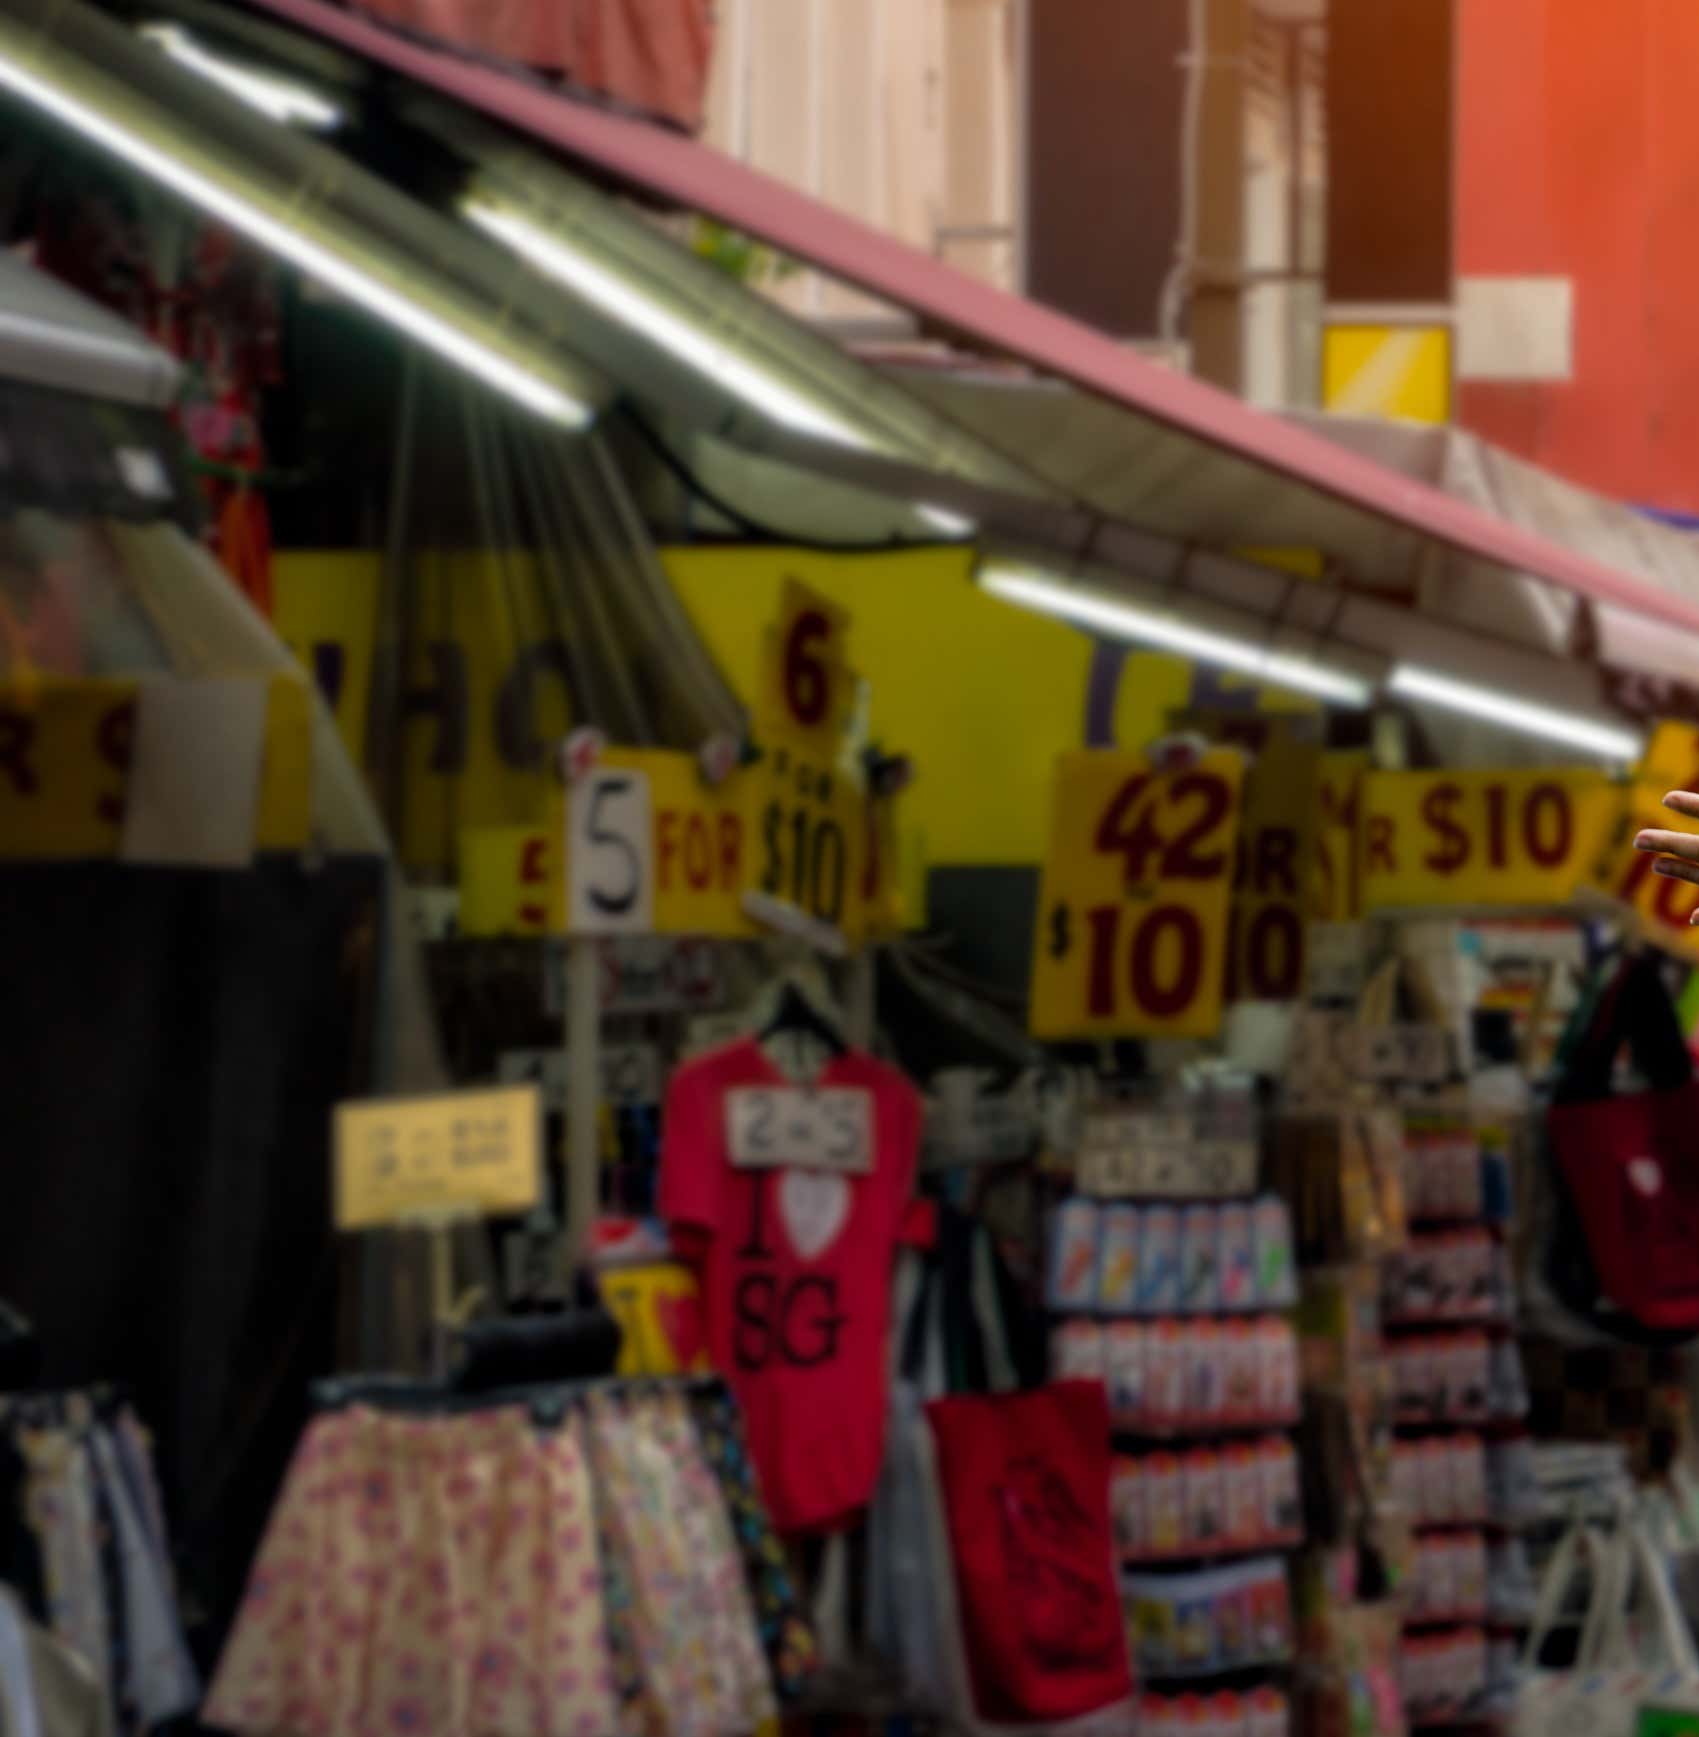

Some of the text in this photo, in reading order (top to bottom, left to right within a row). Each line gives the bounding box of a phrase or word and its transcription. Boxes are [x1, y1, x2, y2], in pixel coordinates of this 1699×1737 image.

[783, 608, 830, 726] 6
[586, 779, 639, 912] 5
[658, 810, 742, 892] FOR
[762, 800, 846, 930] $10
[1095, 772, 1232, 884] 42
[1418, 782, 1573, 873] $10
[732, 1272, 844, 1371] SG
